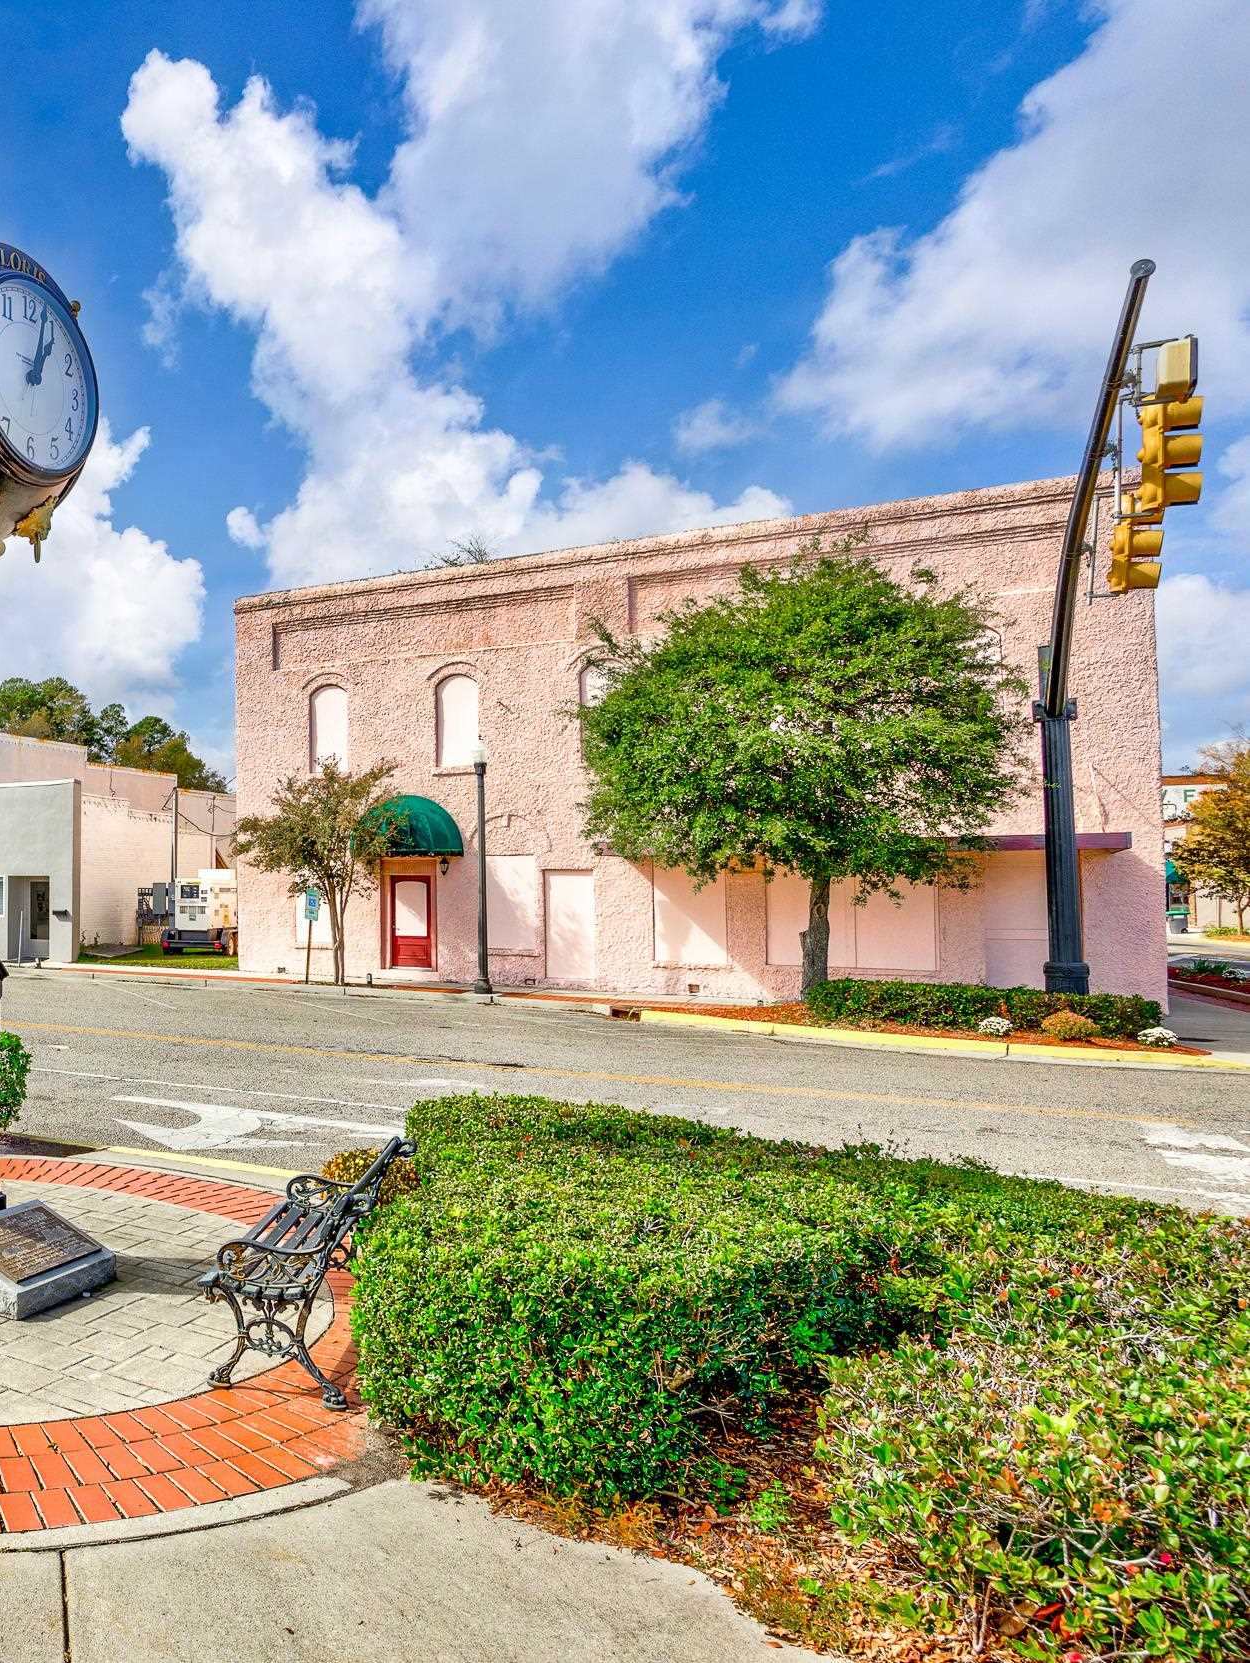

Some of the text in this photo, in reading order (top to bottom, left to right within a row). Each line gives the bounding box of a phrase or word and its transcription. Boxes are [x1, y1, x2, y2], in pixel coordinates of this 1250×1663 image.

[0, 247, 48, 284] LORIS
[1, 293, 14, 321] 11
[22, 295, 37, 324] 12
[64, 352, 74, 378] 2
[71, 388, 79, 412] 3
[0, 416, 11, 436] 7
[64, 417, 74, 442] 4
[26, 436, 35, 460] 6
[50, 436, 60, 460] 5
